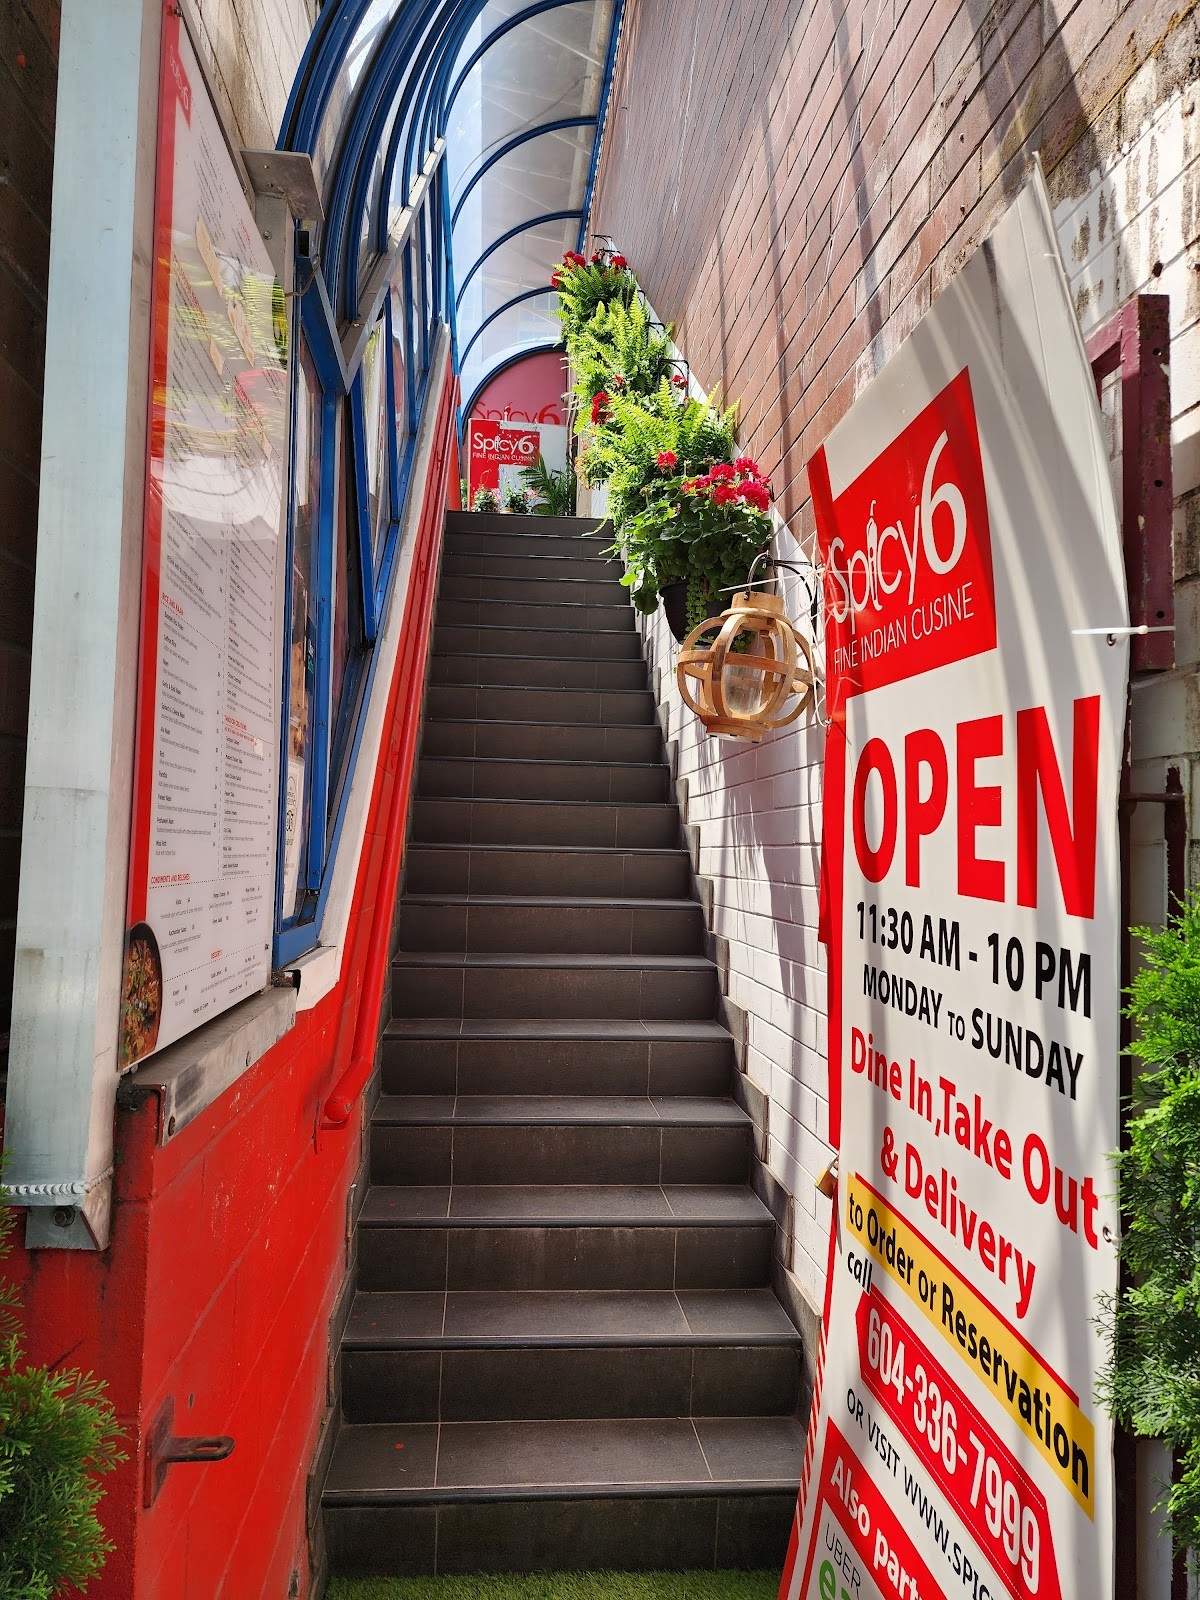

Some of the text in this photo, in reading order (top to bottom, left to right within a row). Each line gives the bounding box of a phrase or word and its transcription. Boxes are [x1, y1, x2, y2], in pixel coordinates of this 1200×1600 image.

[473, 432, 535, 455] Spicy6
[828, 430, 967, 635] Spicy6
[834, 582, 974, 674] FINE INDIAN CUSINE
[852, 695, 1101, 920] OPEN
[857, 901, 914, 946] 11:30
[919, 914, 961, 971] AM
[988, 932, 1024, 992] 10
[1035, 942, 1092, 1018] PM
[863, 964, 1084, 1101] MONDAY TO SUNDAY
[851, 1026, 902, 1101] Dine
[1023, 1133, 1099, 1250] Out
[847, 1251, 873, 1293] call
[880, 1126, 1036, 1319] & Delivery
[849, 1193, 1090, 1499] to Order or Reservation
[830, 1456, 922, 1600] Also part
[847, 1388, 997, 1600] OR VISIT WWW.SPIC
[867, 1307, 1040, 1595] 604-336-7999
[825, 1523, 861, 1600] UBER
